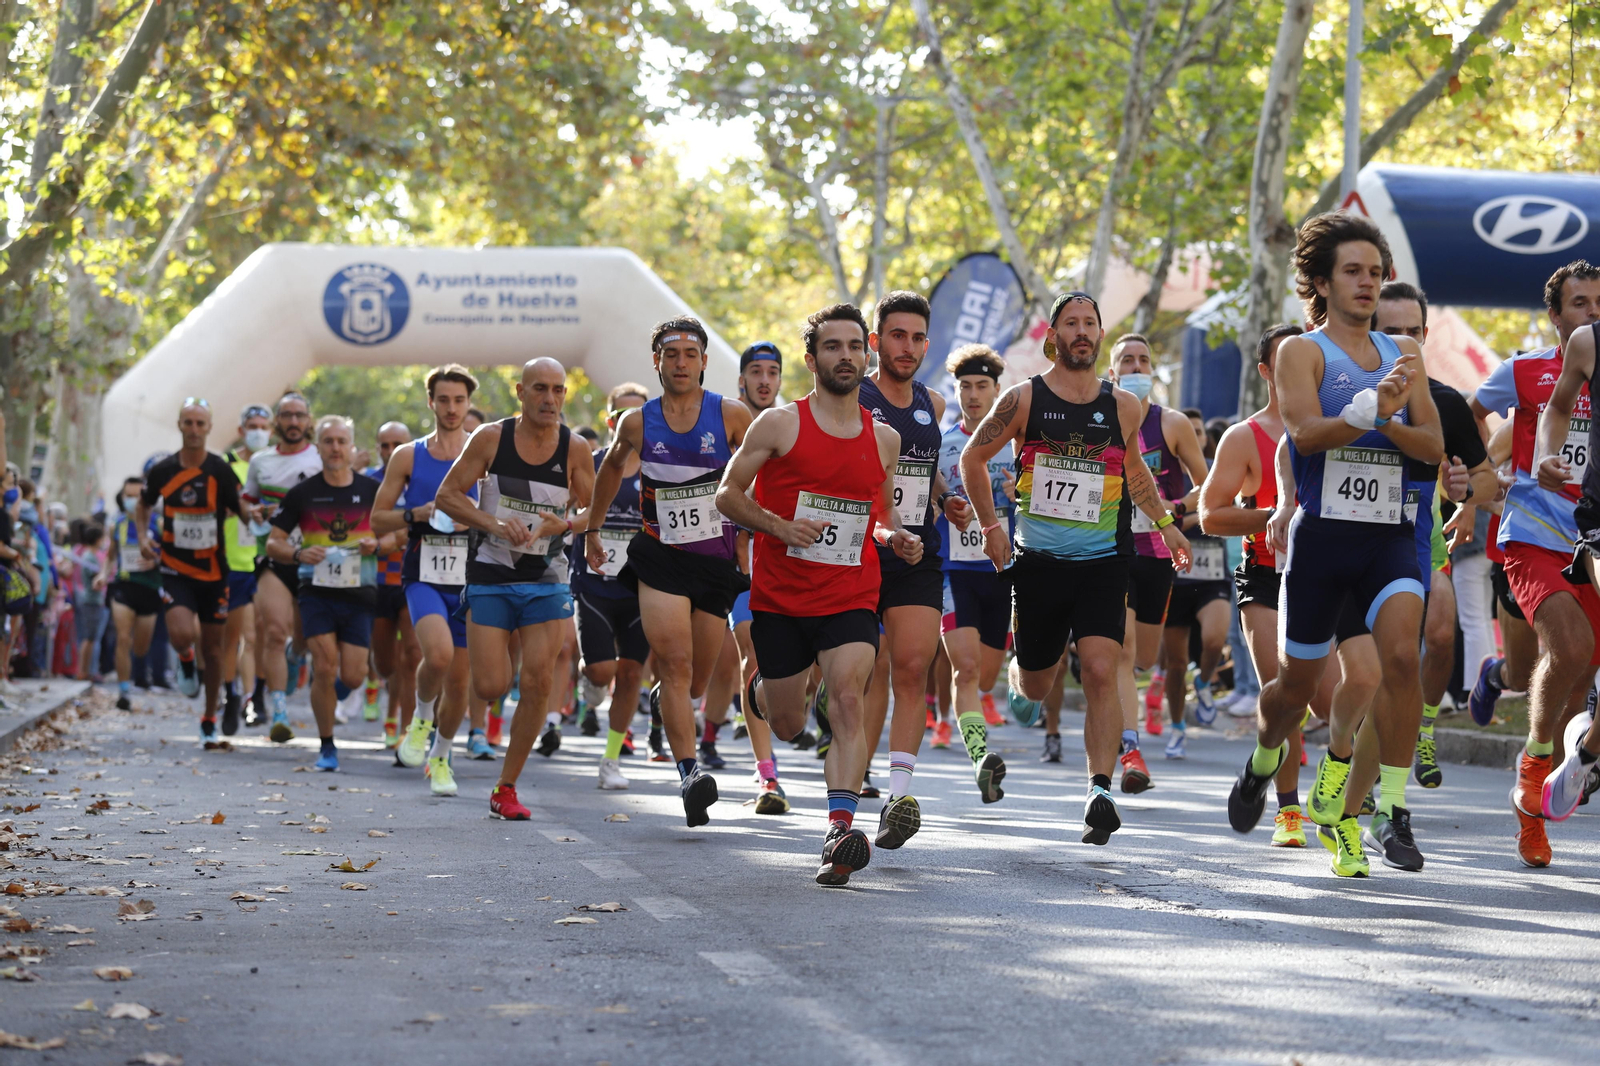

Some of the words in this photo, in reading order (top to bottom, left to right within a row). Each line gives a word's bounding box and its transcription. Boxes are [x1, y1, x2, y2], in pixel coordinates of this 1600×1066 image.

[416, 271, 578, 291] Ayuntamiento
[462, 291, 490, 308] de
[498, 291, 578, 308] Huelva
[1043, 412, 1066, 420] GOBIK
[1332, 450, 1341, 460] 34
[1343, 450, 1371, 462] VUELTA
[1372, 453, 1378, 463] A
[1379, 453, 1400, 465] HUELVA
[1557, 444, 1587, 466] 56
[904, 466, 909, 475] A
[909, 465, 928, 476] HUELVA
[1040, 457, 1047, 466] 34
[1048, 458, 1071, 470] VUELTA
[1072, 461, 1077, 470] A
[1077, 462, 1100, 473] HUELVA
[1048, 468, 1074, 477] MARIANO
[666, 489, 688, 499] VUELTA
[688, 489, 693, 497] A
[693, 485, 715, 496] HUELVA
[1044, 479, 1079, 503] 177
[1337, 476, 1379, 503] 490
[510, 501, 530, 512] VUELTA
[803, 496, 812, 506] 34
[814, 498, 838, 511] VUELTA
[839, 502, 845, 512] A
[845, 503, 867, 514] HUELVA
[668, 508, 700, 529] 315
[182, 527, 204, 541] 453
[431, 555, 457, 571] 117
